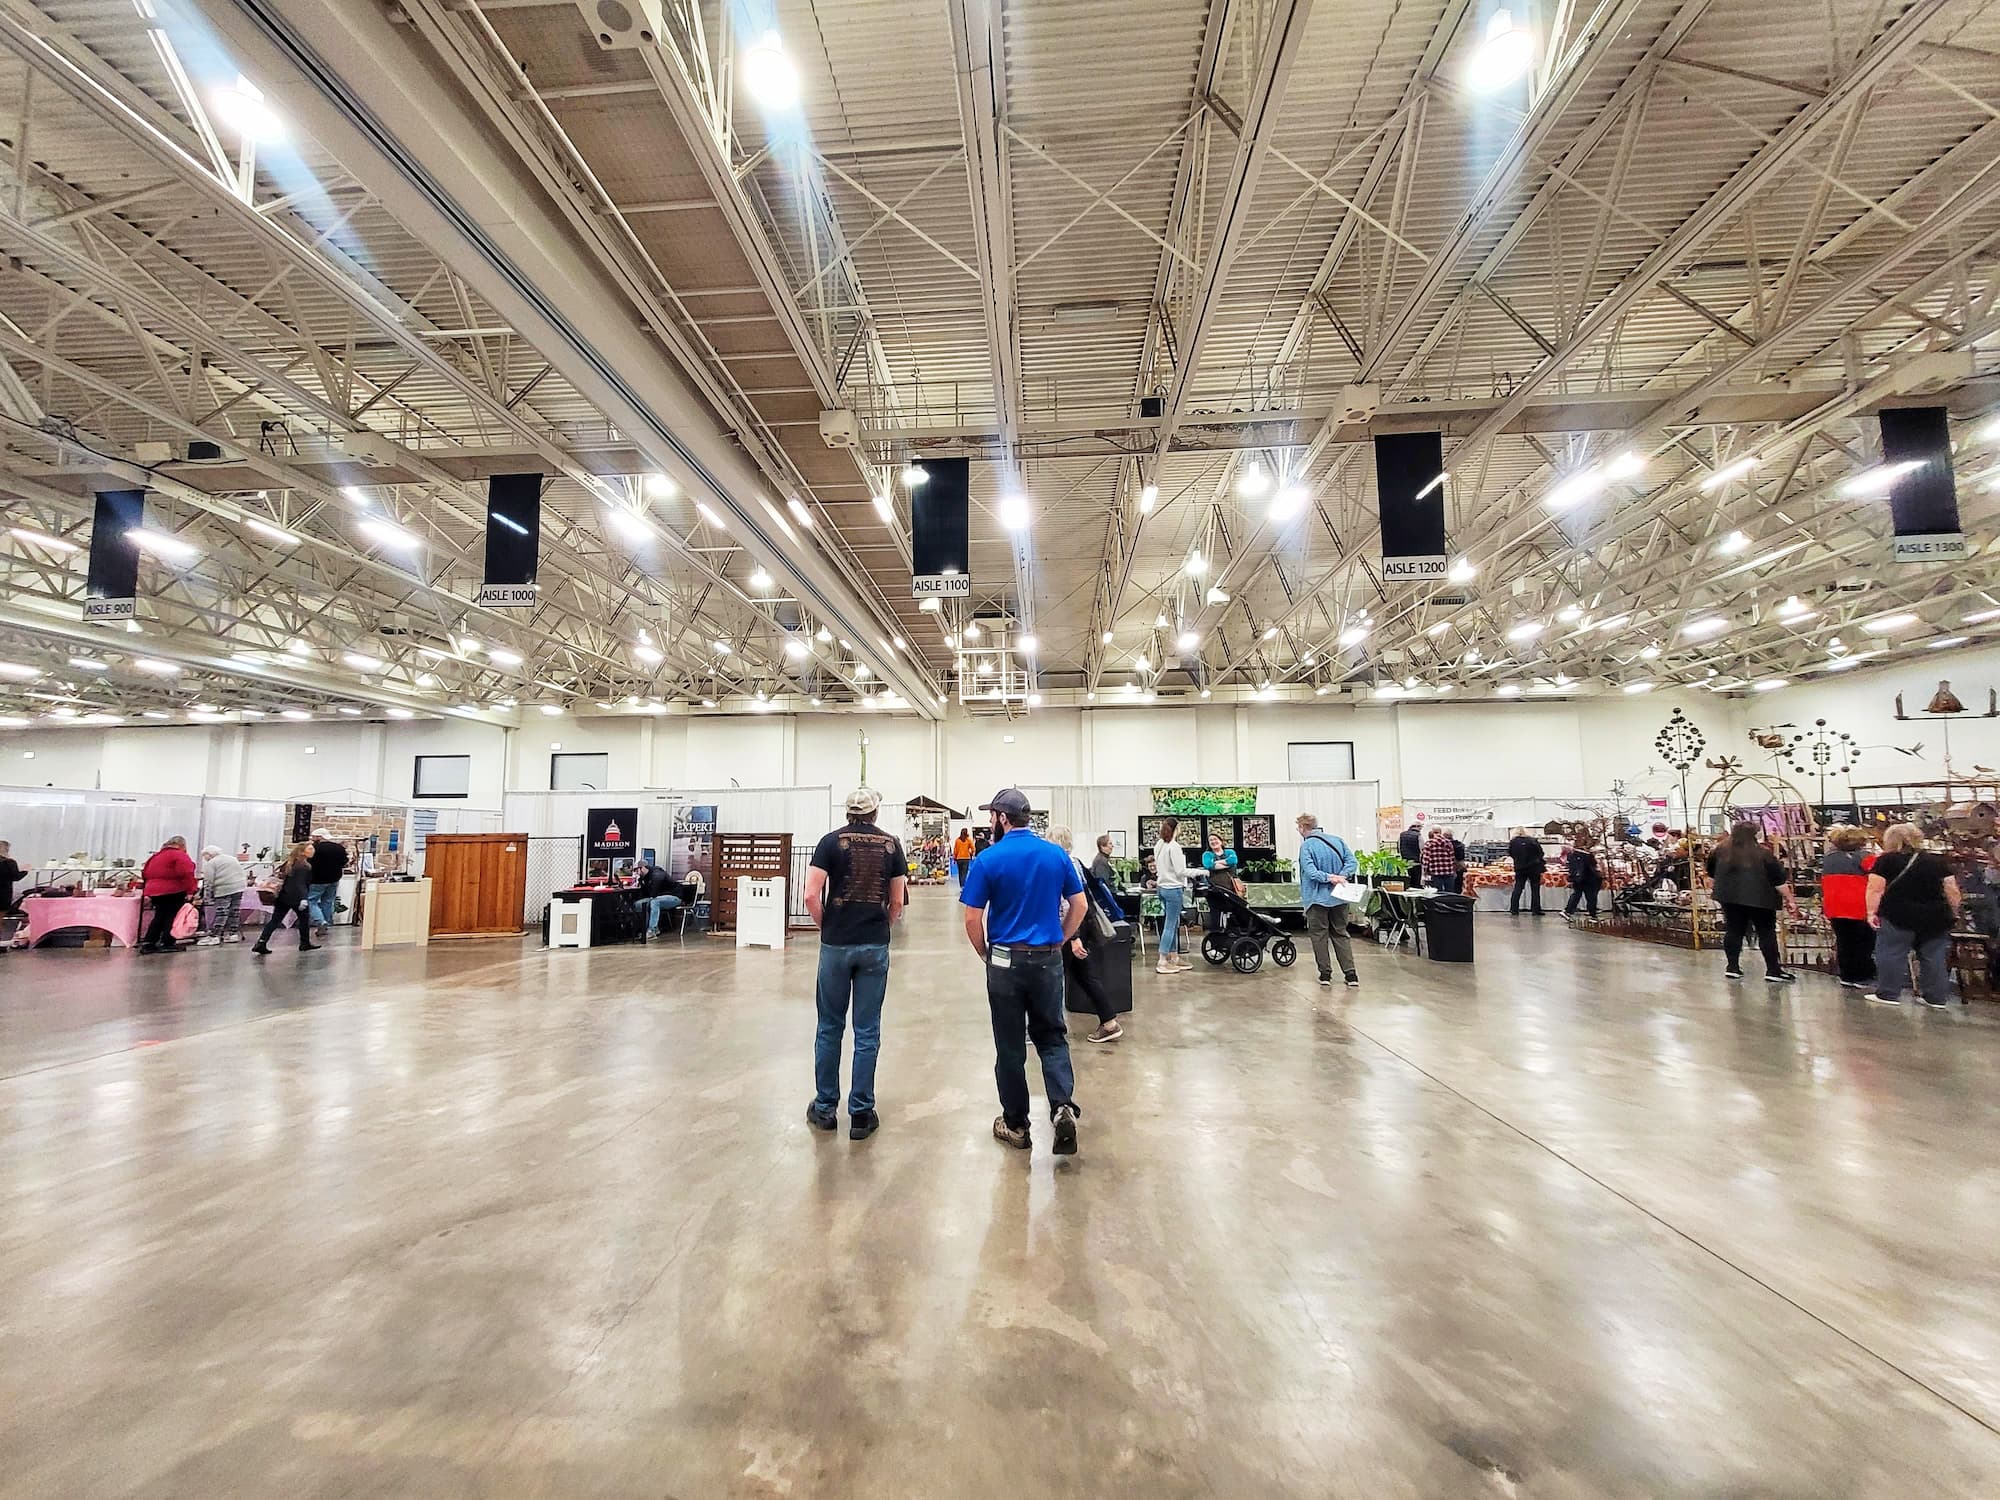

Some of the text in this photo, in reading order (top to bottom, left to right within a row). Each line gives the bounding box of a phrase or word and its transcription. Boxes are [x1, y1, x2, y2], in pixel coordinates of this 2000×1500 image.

[1897, 541, 1964, 553] AISLE 1300
[1385, 561, 1446, 574] AISLE 1200
[913, 579, 969, 592] AISLE 1100
[481, 590, 534, 600] AISLE 1000
[86, 603, 132, 615] AISLE 900
[1427, 814, 1485, 822] Training Program
[676, 822, 715, 832] EXPERT
